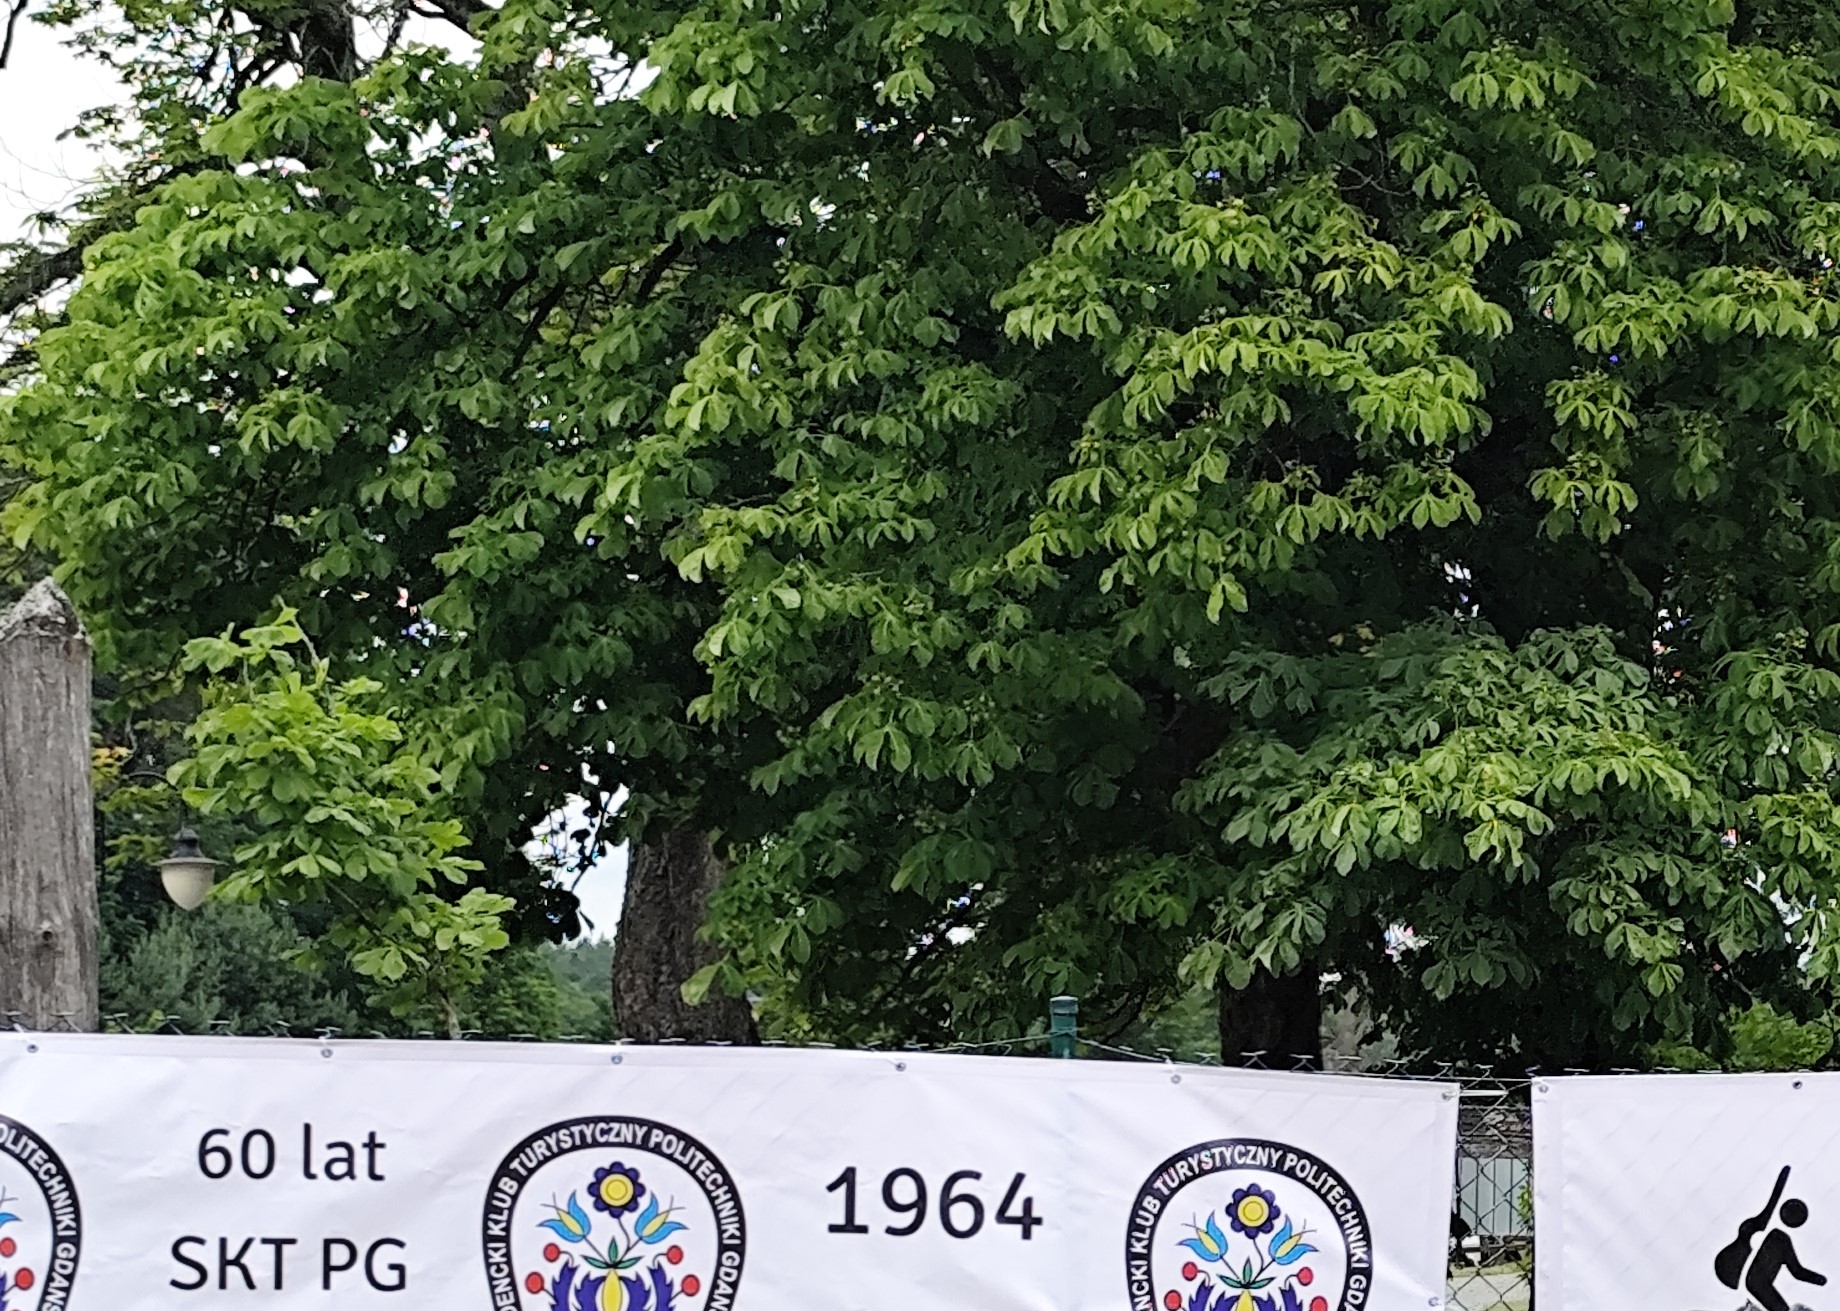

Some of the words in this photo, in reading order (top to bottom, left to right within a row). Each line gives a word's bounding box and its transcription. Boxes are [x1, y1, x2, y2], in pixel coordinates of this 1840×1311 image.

[198, 1128, 276, 1181] 60
[302, 1122, 386, 1182] lat
[487, 1176, 519, 1236] KLUB
[509, 1121, 648, 1177] TURYSTYCZNY
[648, 1128, 742, 1246] POLITECHNIKI
[825, 1165, 1044, 1241] 1964
[1130, 1197, 1161, 1254] KLUB
[1153, 1145, 1284, 1196] TURYSTYCZNY
[1283, 1152, 1370, 1268] POLITECHNIKI
[169, 1235, 298, 1291] SKT
[321, 1237, 407, 1292] PG
